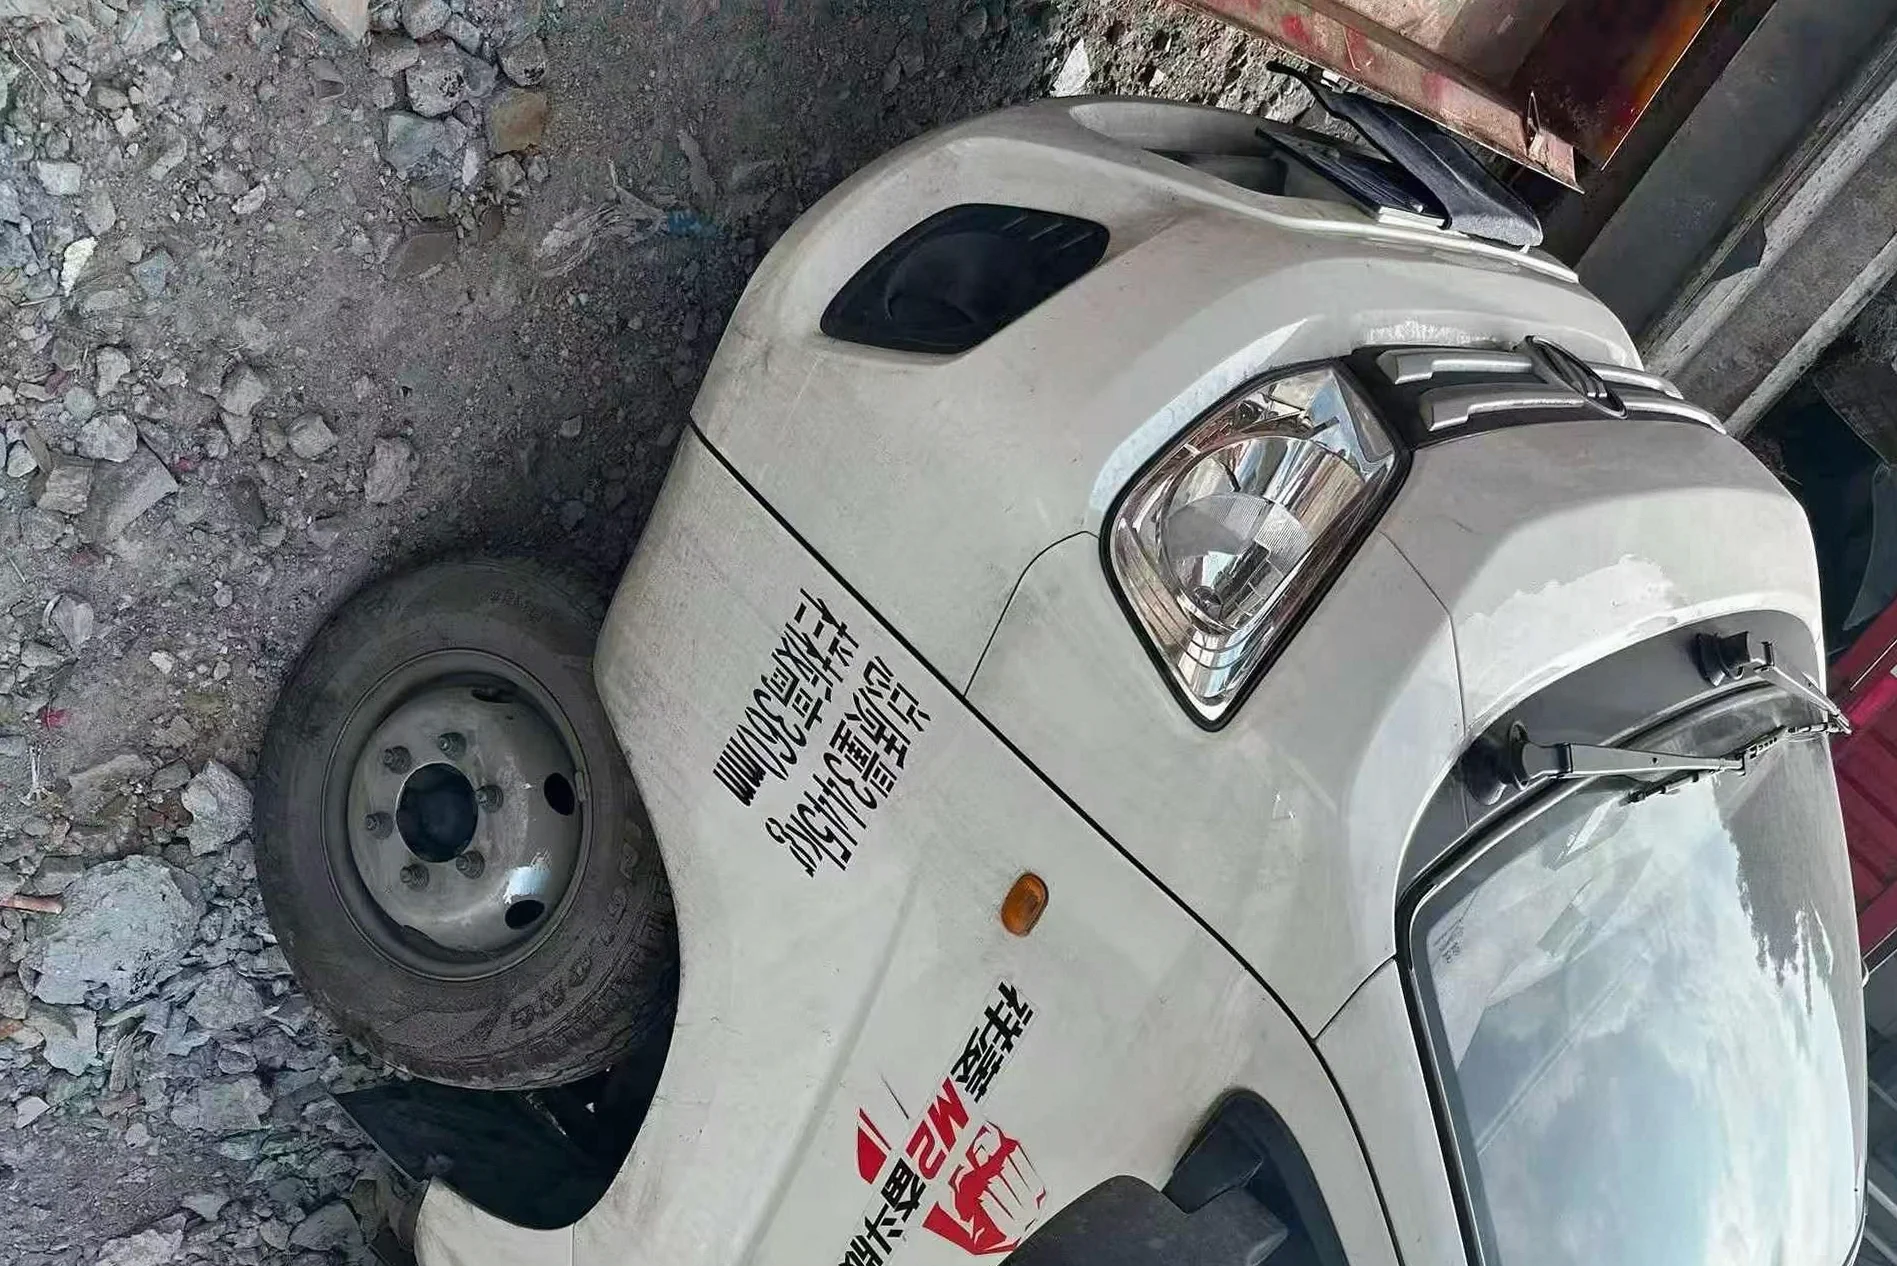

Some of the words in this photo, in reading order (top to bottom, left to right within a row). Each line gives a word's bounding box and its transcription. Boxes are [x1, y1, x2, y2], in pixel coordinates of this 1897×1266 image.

[713, 588, 859, 806] 栏板高360mm
[766, 656, 930, 877] 总质量3445kg
